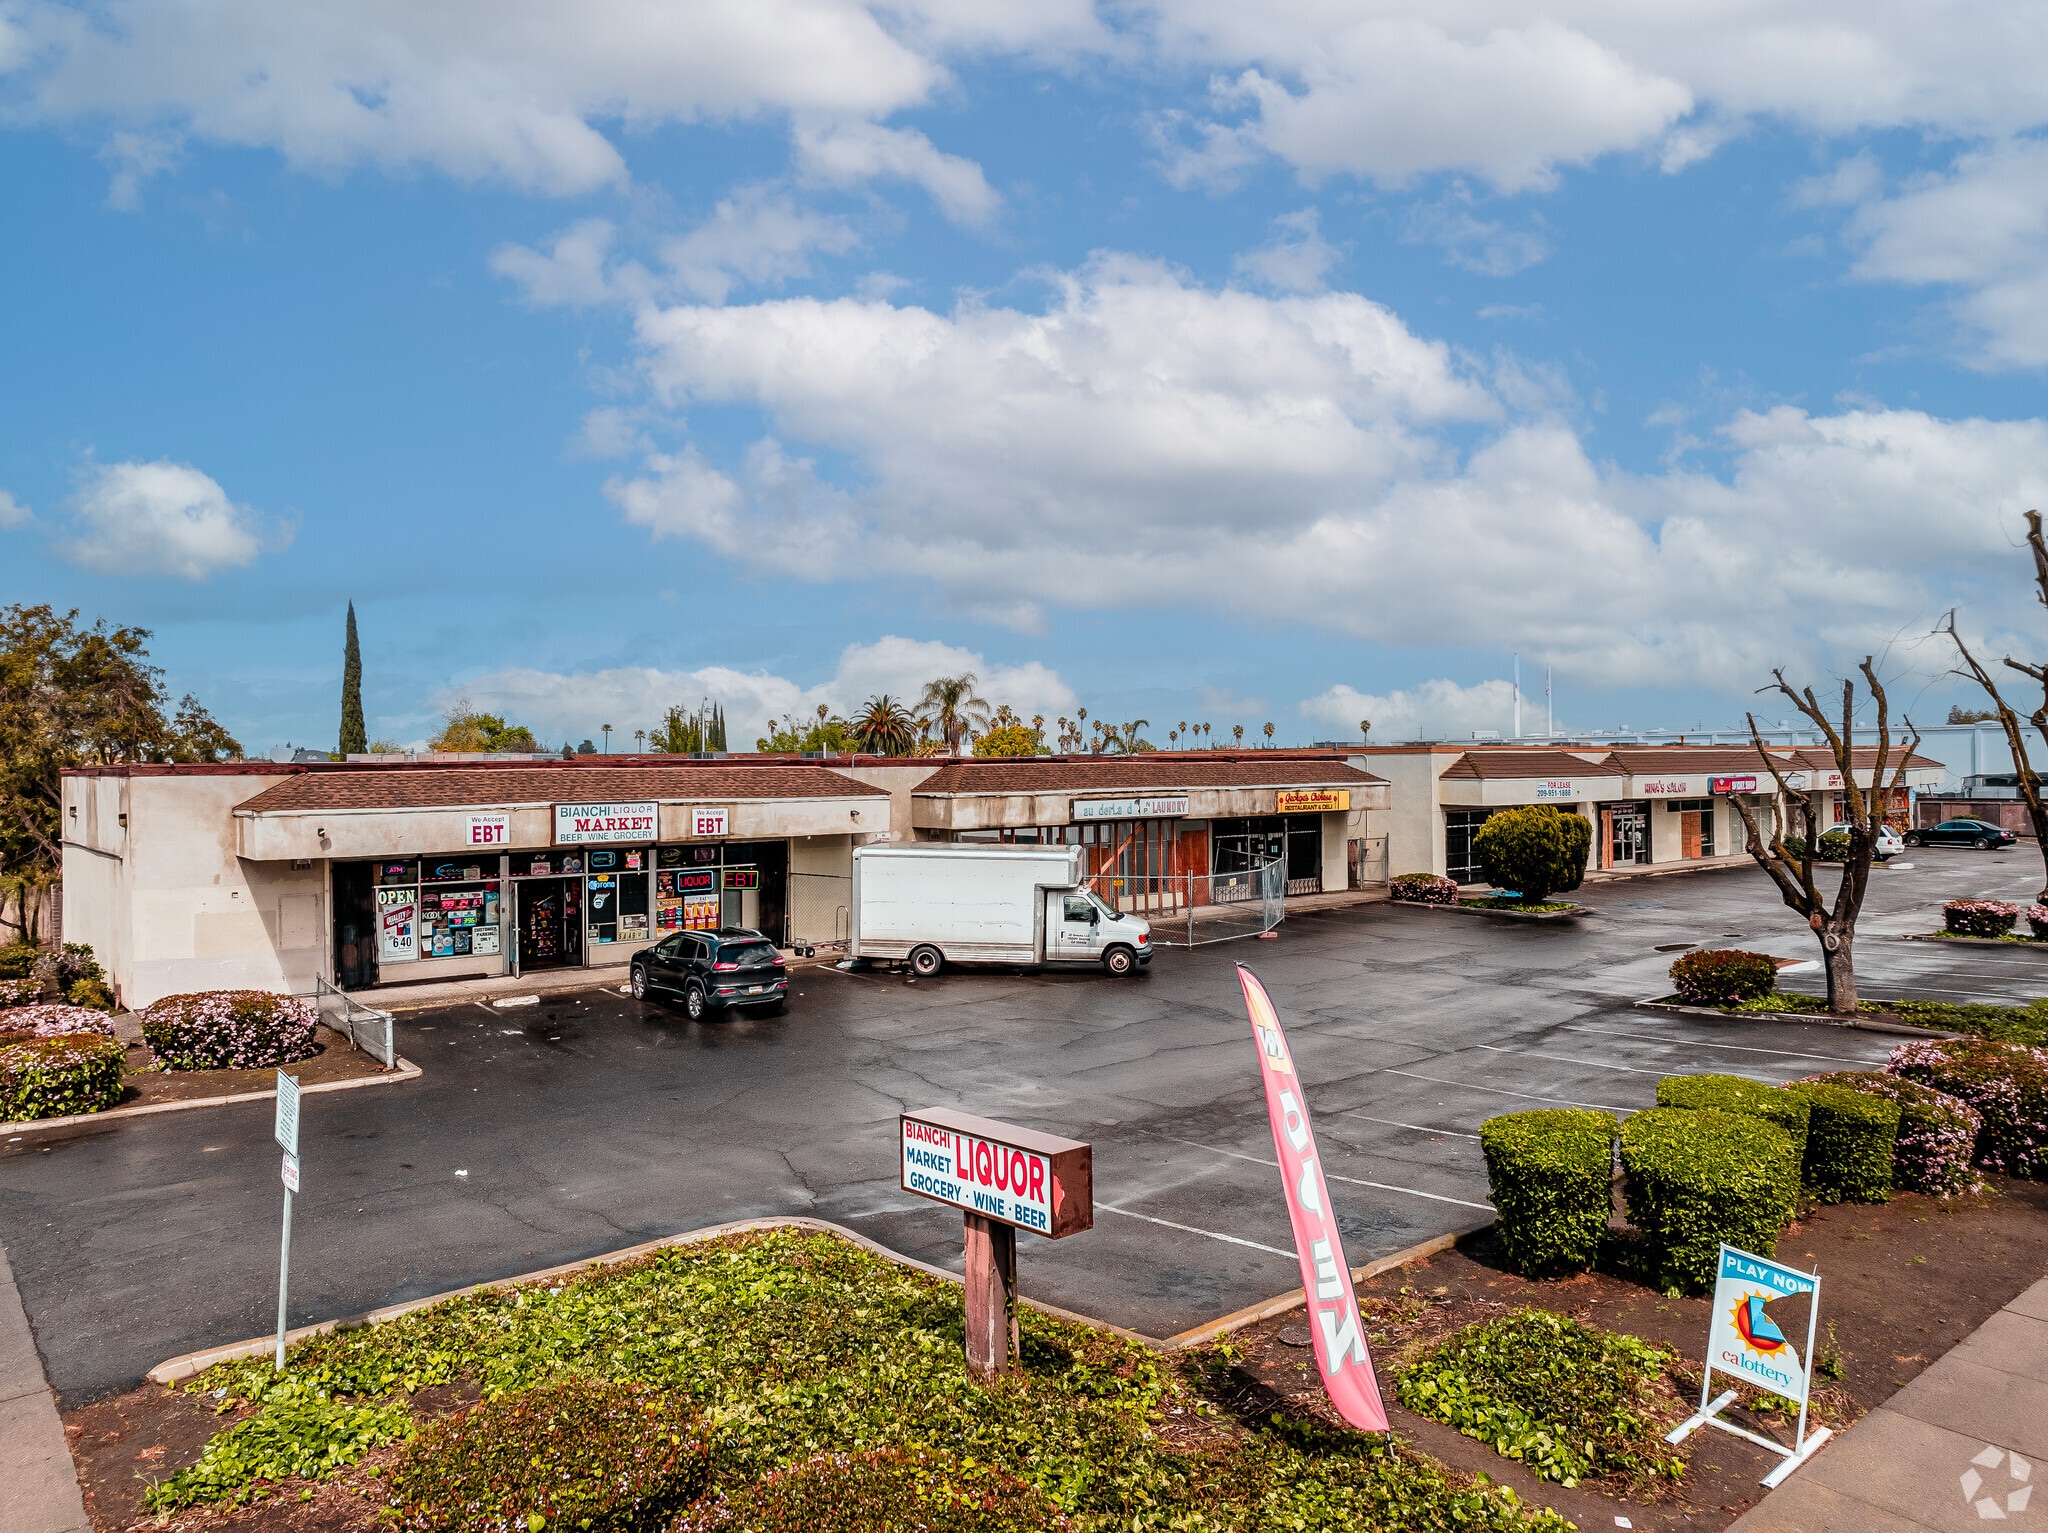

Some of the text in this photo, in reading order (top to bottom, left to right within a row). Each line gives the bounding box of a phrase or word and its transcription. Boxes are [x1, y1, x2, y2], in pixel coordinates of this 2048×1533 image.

[1666, 782, 1686, 793] SALON
[560, 805, 653, 818] BIANCHI LIQUOR
[1152, 800, 1186, 814] LAUNDRY
[574, 816, 653, 832] MARKET
[697, 818, 724, 834] EBT
[472, 824, 504, 843] EBT
[560, 830, 653, 842] BEER WINE GROCERY
[588, 880, 615, 890] Corona
[679, 875, 711, 888] LIQUOR
[724, 872, 756, 887] EBT
[378, 889, 416, 904] OPEN
[422, 911, 441, 920] KOOL
[906, 1146, 952, 1174] MARKET
[906, 1122, 1045, 1204] BIANCHI LIQUOR
[910, 1172, 1046, 1230] GROCERY WINE BEER
[1726, 1256, 1813, 1294] PLAY NOW
[1722, 1348, 1792, 1388] calottery
